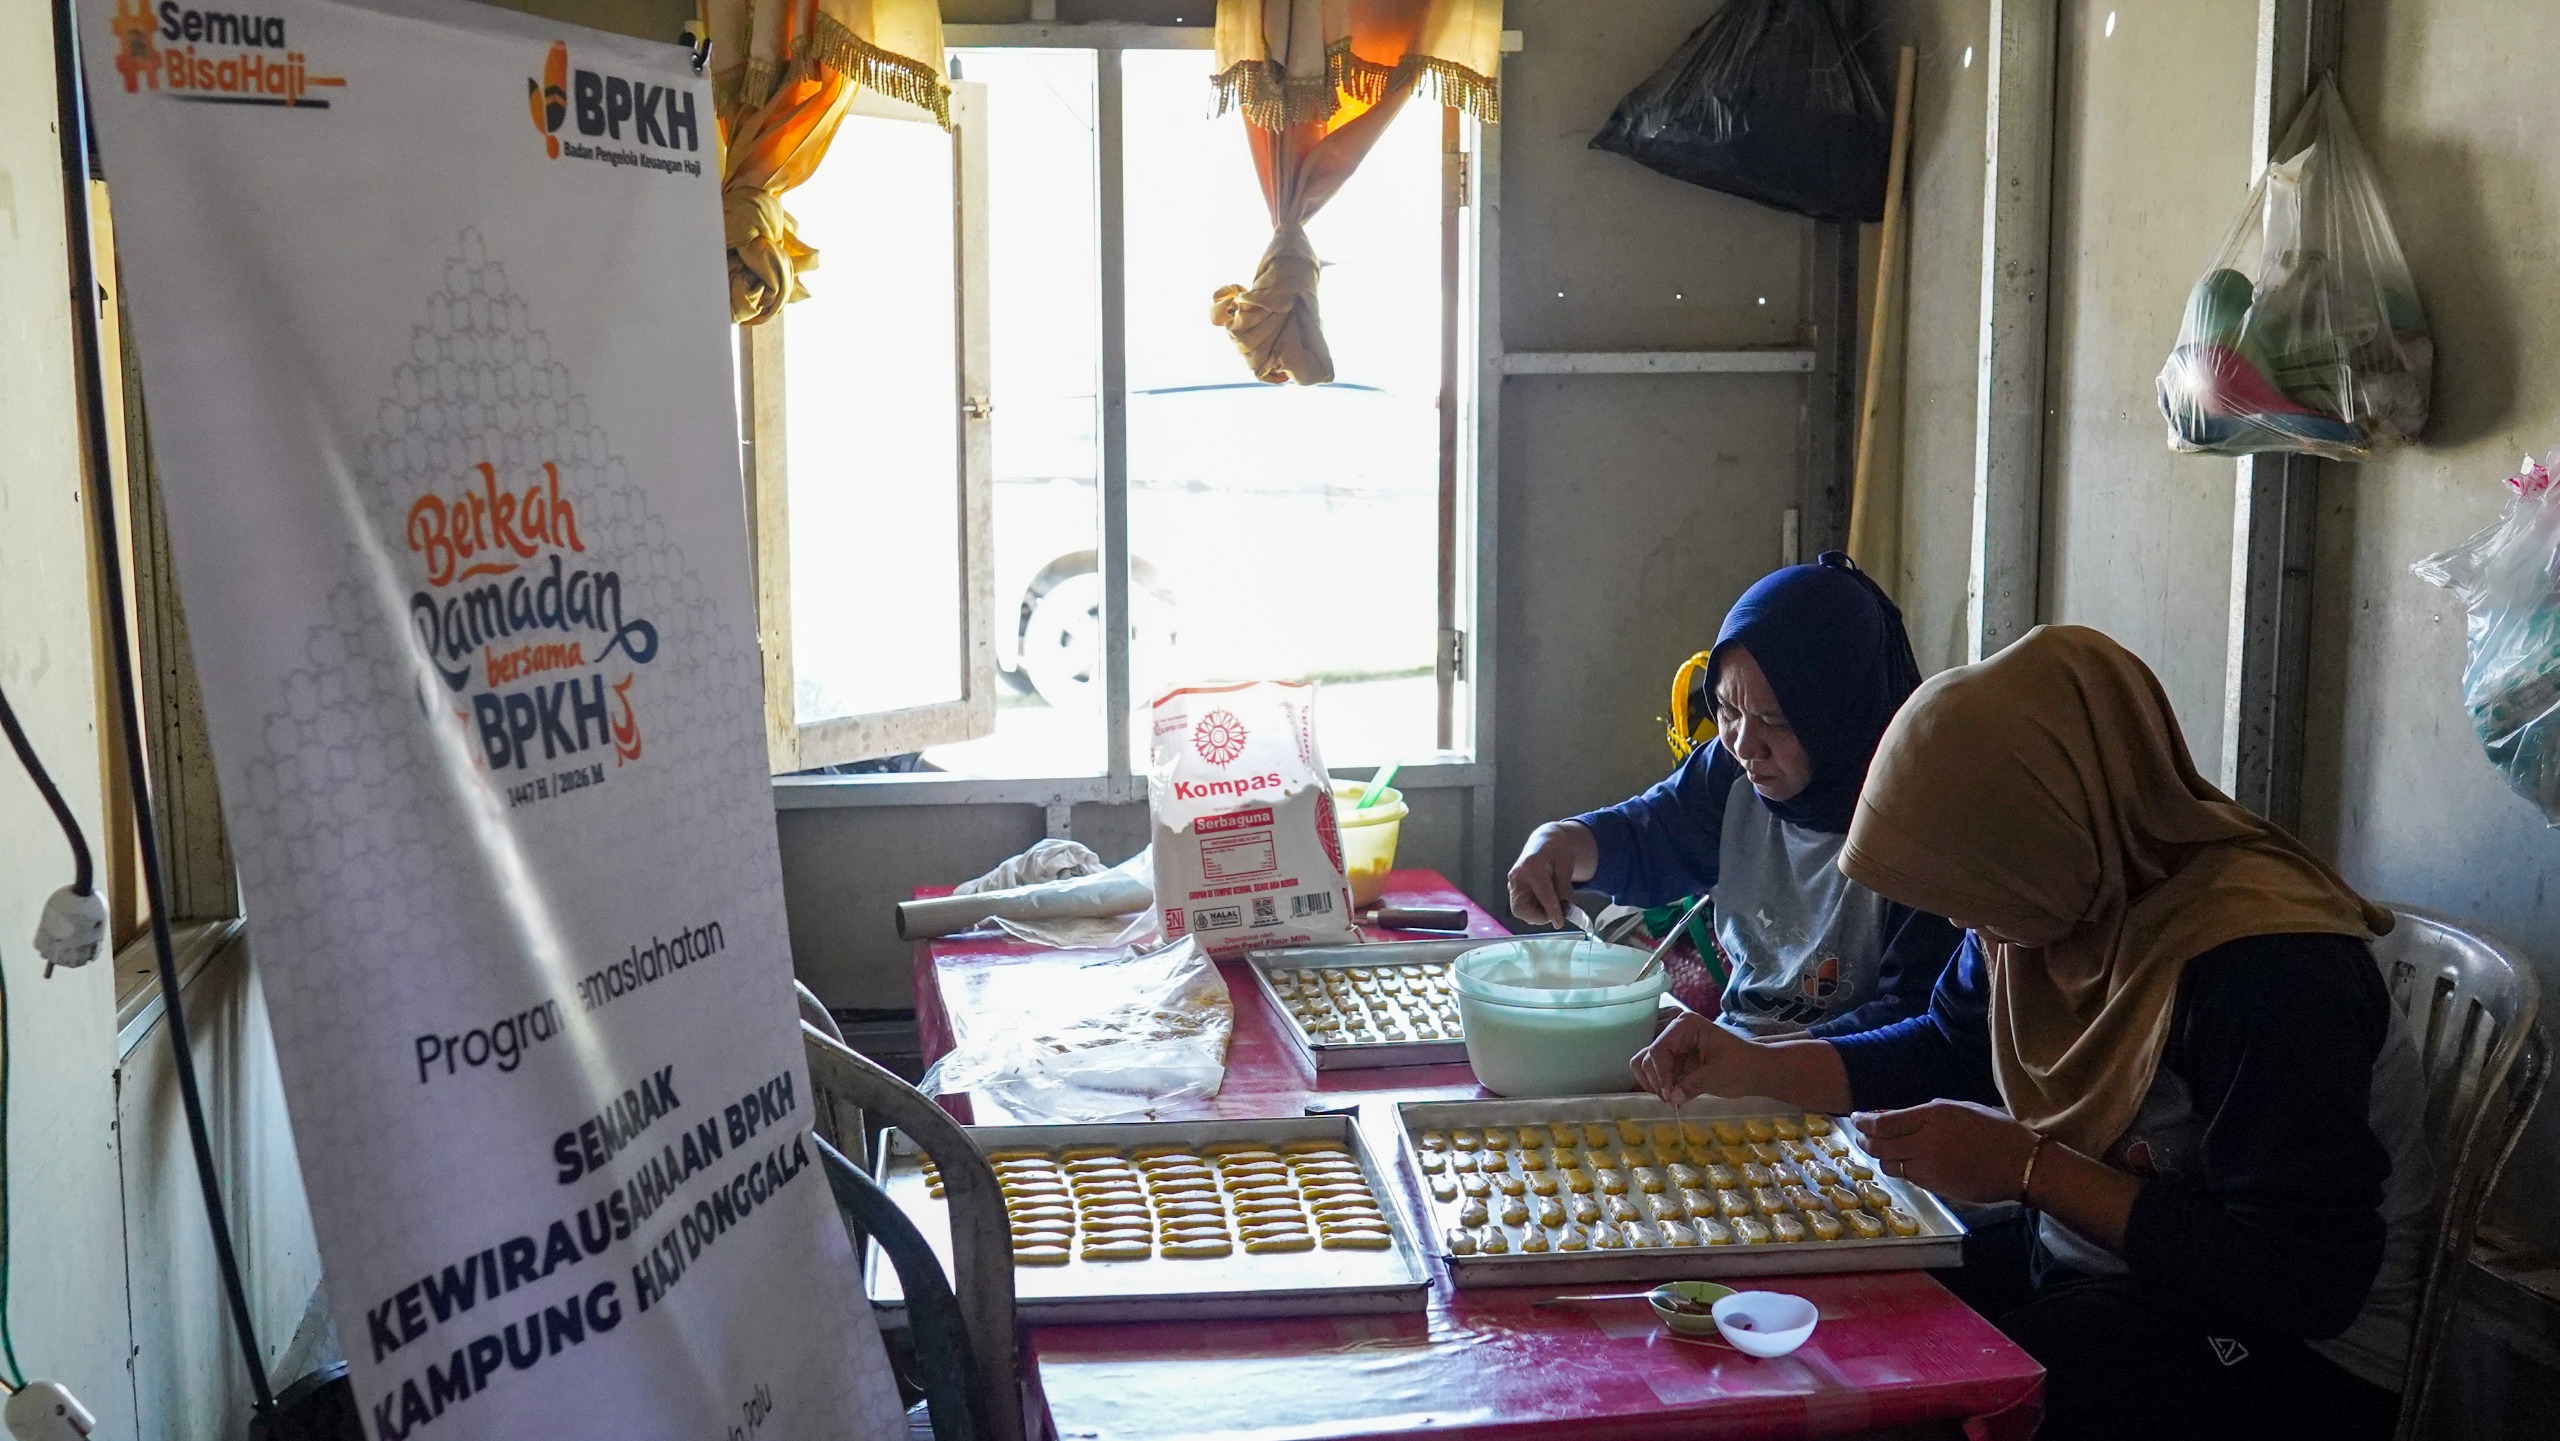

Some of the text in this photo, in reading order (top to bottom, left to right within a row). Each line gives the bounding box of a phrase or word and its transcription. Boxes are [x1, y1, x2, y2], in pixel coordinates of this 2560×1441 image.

[159, 0, 285, 48] Semua
[165, 45, 306, 108] BisaHaji
[574, 70, 699, 152] BPKH
[564, 141, 702, 178] Badan Pengelola Keuangan Haji
[407, 462, 585, 586] Berkah
[410, 554, 659, 692] Ramadan
[485, 642, 586, 688] bersama
[472, 674, 611, 770] BPKH
[507, 783, 535, 807] 1447
[535, 777, 550, 799] H
[559, 767, 591, 792] 2026
[590, 762, 605, 785] M
[1174, 772, 1282, 800] Kompas
[1196, 812, 1271, 831] Serbaguna
[1165, 910, 1185, 928] SNI
[1210, 910, 1238, 919] HALAL
[1241, 939, 1265, 949] Pearl
[1265, 937, 1289, 946] Flour
[1290, 933, 1312, 943] Mills
[553, 1064, 681, 1185] SEMARAK
[728, 1070, 796, 1151] BPKH
[373, 1130, 810, 1441] KAMPUNG HAJI DONGGALA
